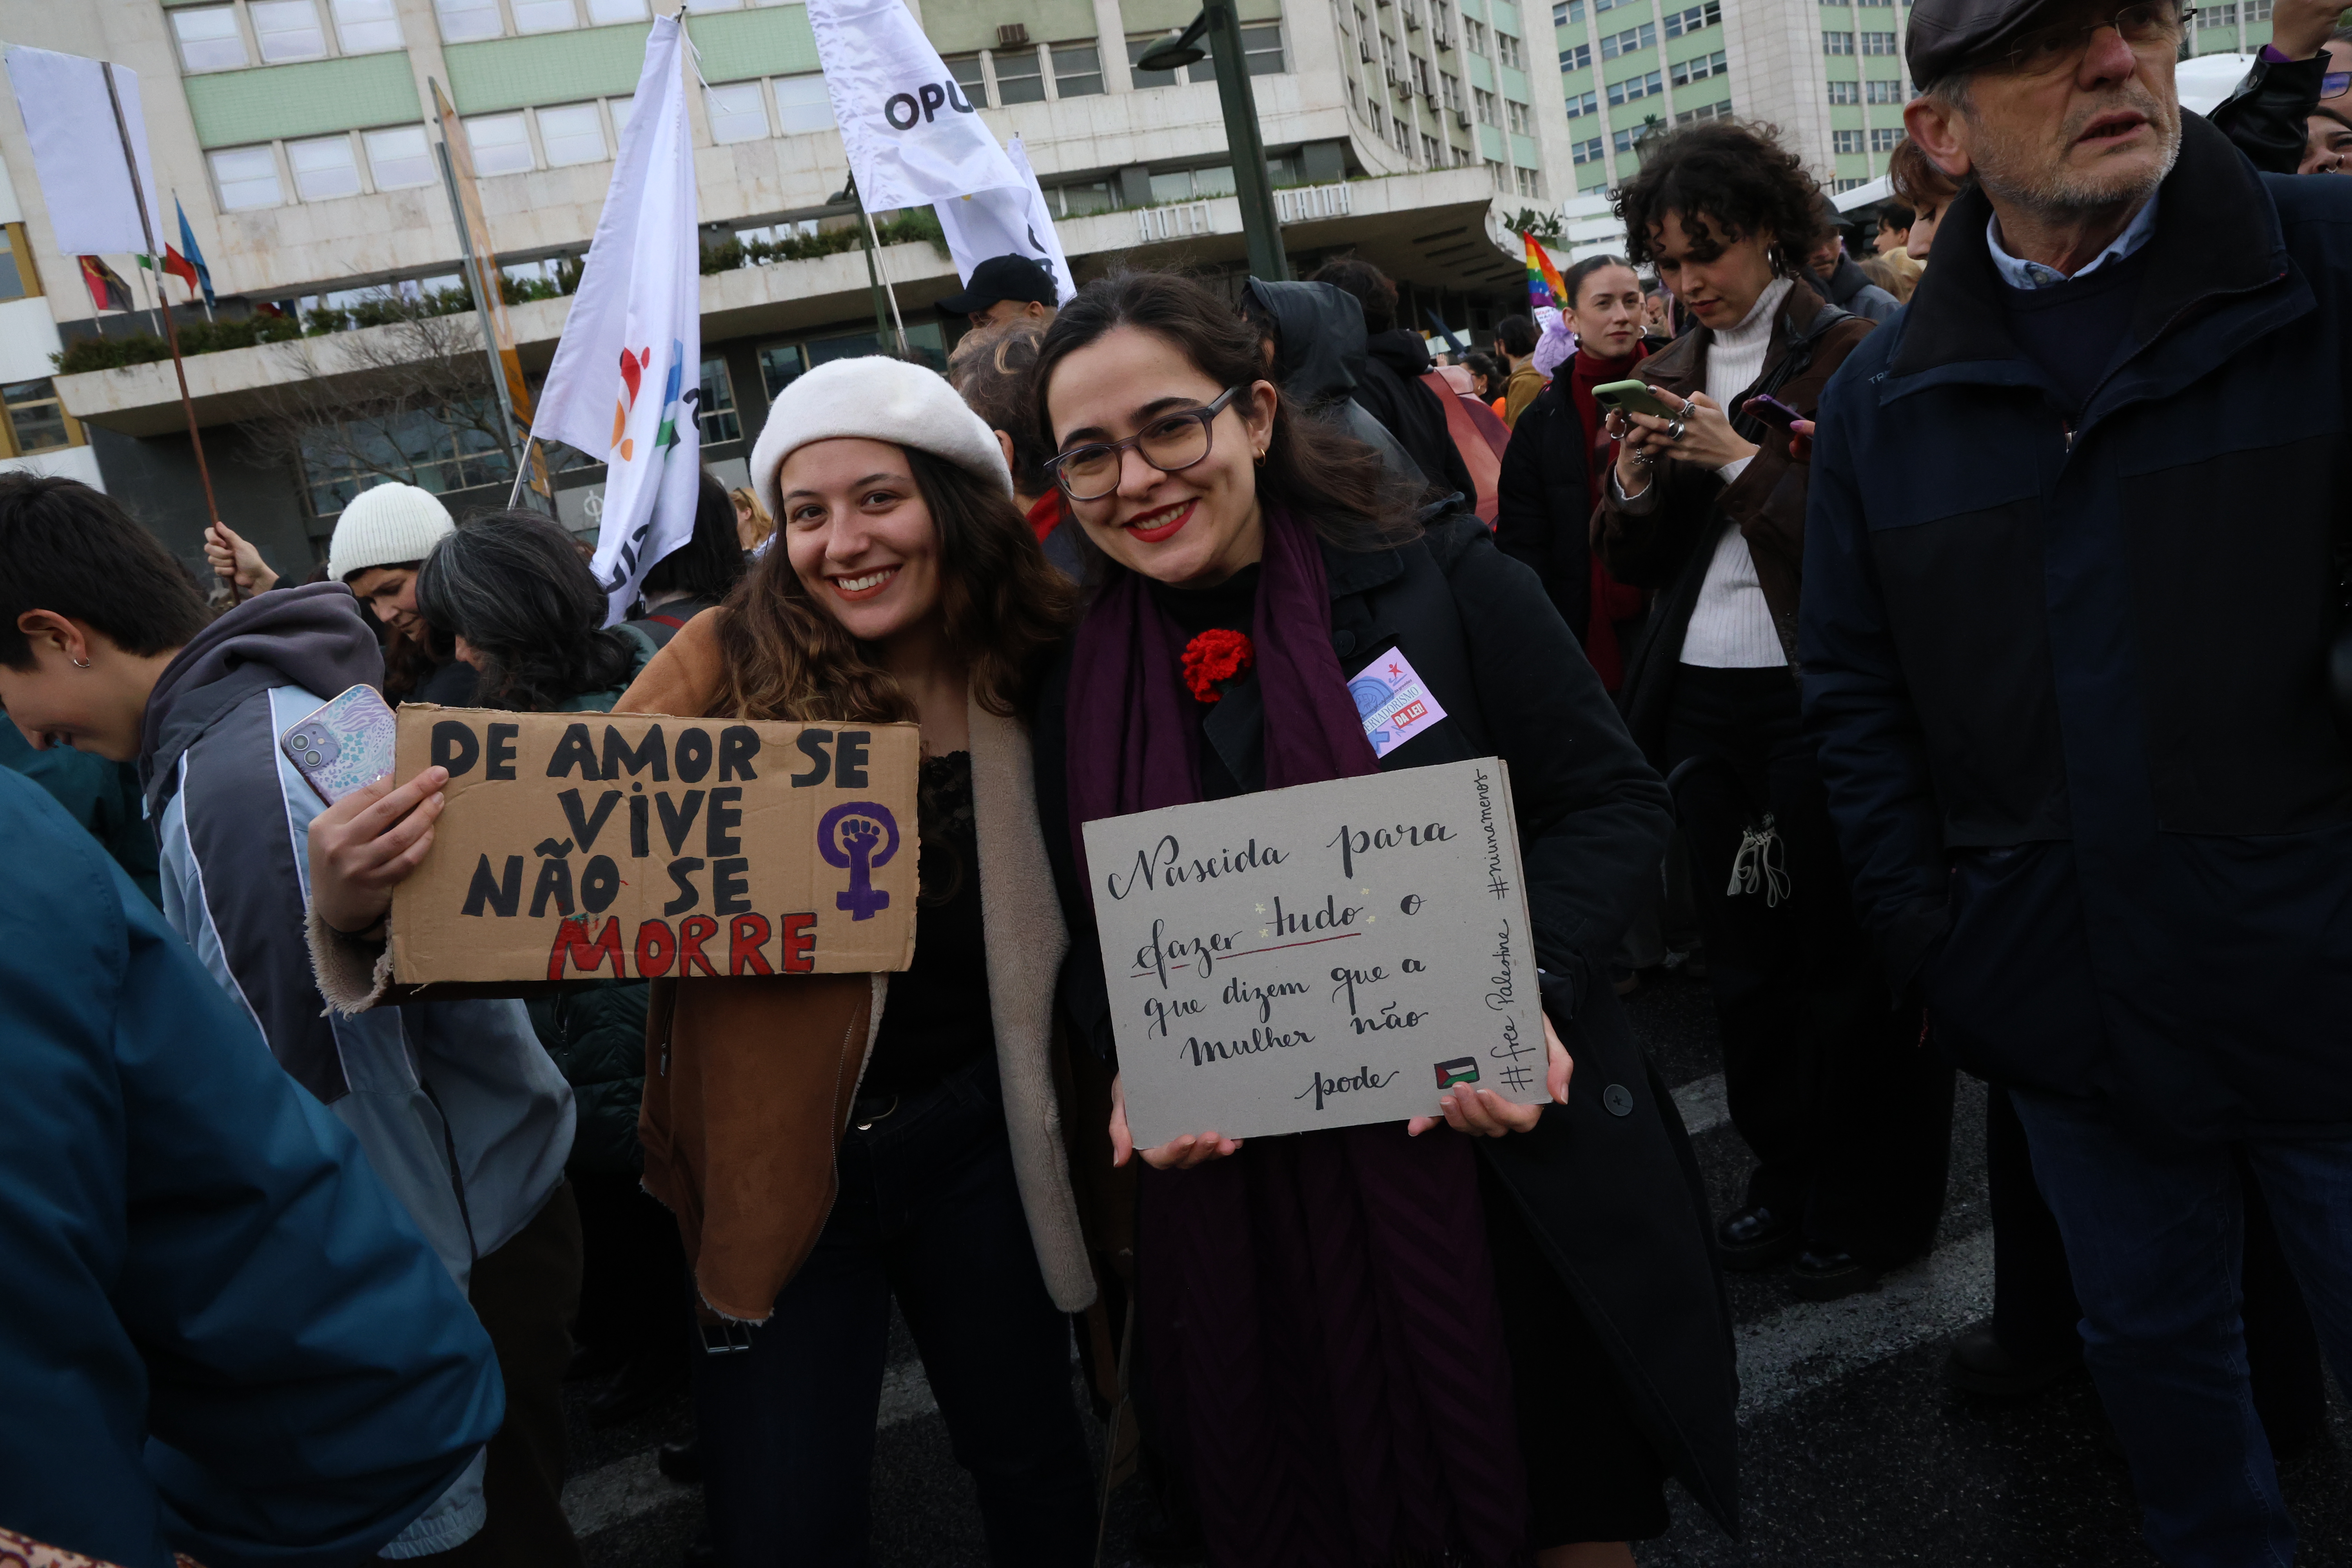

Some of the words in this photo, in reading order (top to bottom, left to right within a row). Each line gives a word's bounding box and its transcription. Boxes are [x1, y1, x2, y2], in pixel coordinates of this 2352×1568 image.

[1363, 686, 1419, 733] ERVADORISMO
[1394, 712, 1410, 726] DA
[1406, 703, 1425, 719] LEI!
[431, 720, 519, 780] DE
[546, 723, 760, 783] AMOR
[791, 729, 871, 788] SE
[461, 837, 619, 917] NÃO
[664, 857, 751, 916] SE
[1108, 834, 1289, 900] Nascida
[1326, 818, 1457, 880] para
[548, 911, 817, 980] MORRE
[1131, 918, 1243, 989] fazer
[1266, 895, 1364, 936] tudo
[1400, 893, 1427, 916] o
[1485, 918, 1513, 1010] Palestine
[1143, 997, 1207, 1040] que
[1223, 976, 1310, 1023] dizem
[1330, 966, 1390, 1016] que
[1402, 958, 1426, 975] a
[1350, 1000, 1429, 1035] não
[1294, 1066, 1400, 1111] pode
